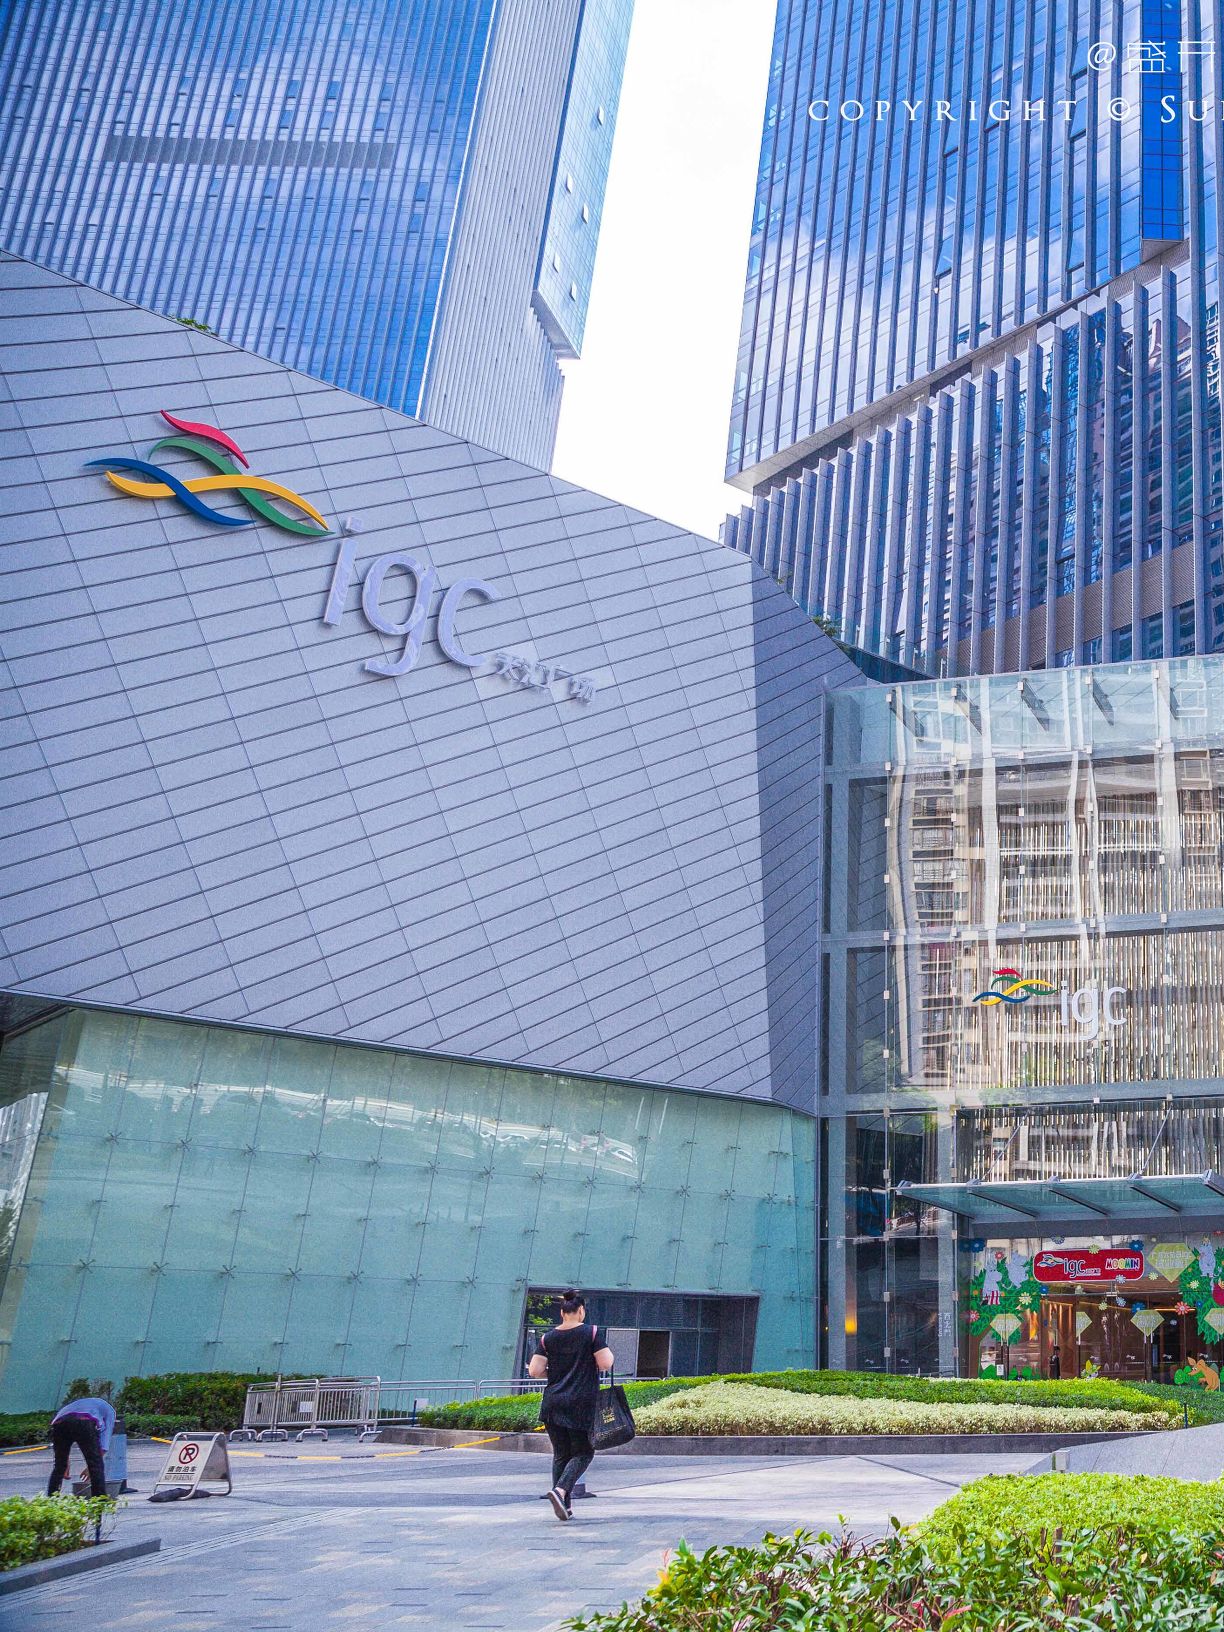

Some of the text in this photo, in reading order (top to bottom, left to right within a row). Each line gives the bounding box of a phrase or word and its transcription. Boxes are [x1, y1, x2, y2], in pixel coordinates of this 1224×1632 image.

[323, 516, 502, 677] igc
[1060, 980, 1127, 1040] igc
[1063, 1257, 1086, 1279] igc
[1104, 1257, 1140, 1271] MOOMIN
